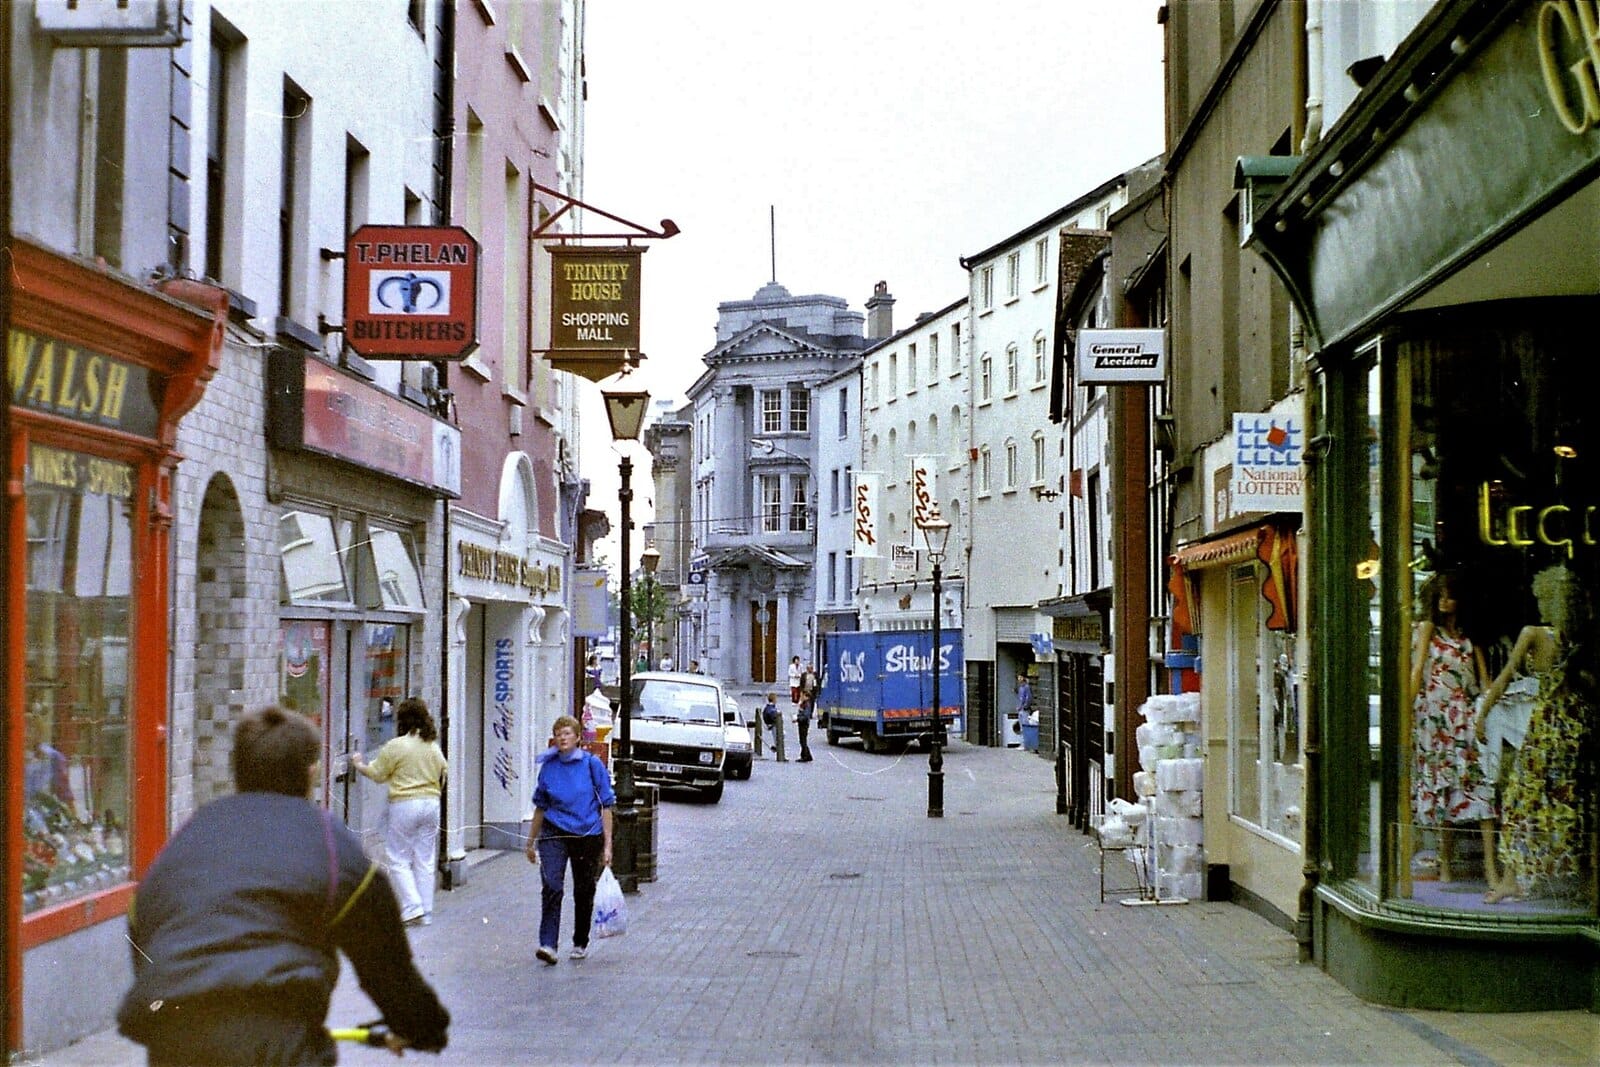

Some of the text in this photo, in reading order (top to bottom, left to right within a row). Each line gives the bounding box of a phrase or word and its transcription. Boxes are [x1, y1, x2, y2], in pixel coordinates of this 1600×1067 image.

[355, 243, 468, 265] T.PHELAN
[563, 263, 629, 281] TRINITY
[571, 283, 622, 301] HOUSE
[562, 313, 629, 326] SHOPPING
[353, 320, 465, 340] BUTCHERS
[577, 328, 613, 341] MALL
[1092, 345, 1141, 354] General
[1100, 356, 1154, 366] Accident
[7, 329, 128, 420] WALSH
[1242, 467, 1305, 480] National
[1237, 482, 1301, 495] LOTTERY
[856, 484, 876, 546] usit
[495, 638, 513, 702] SPORTS
